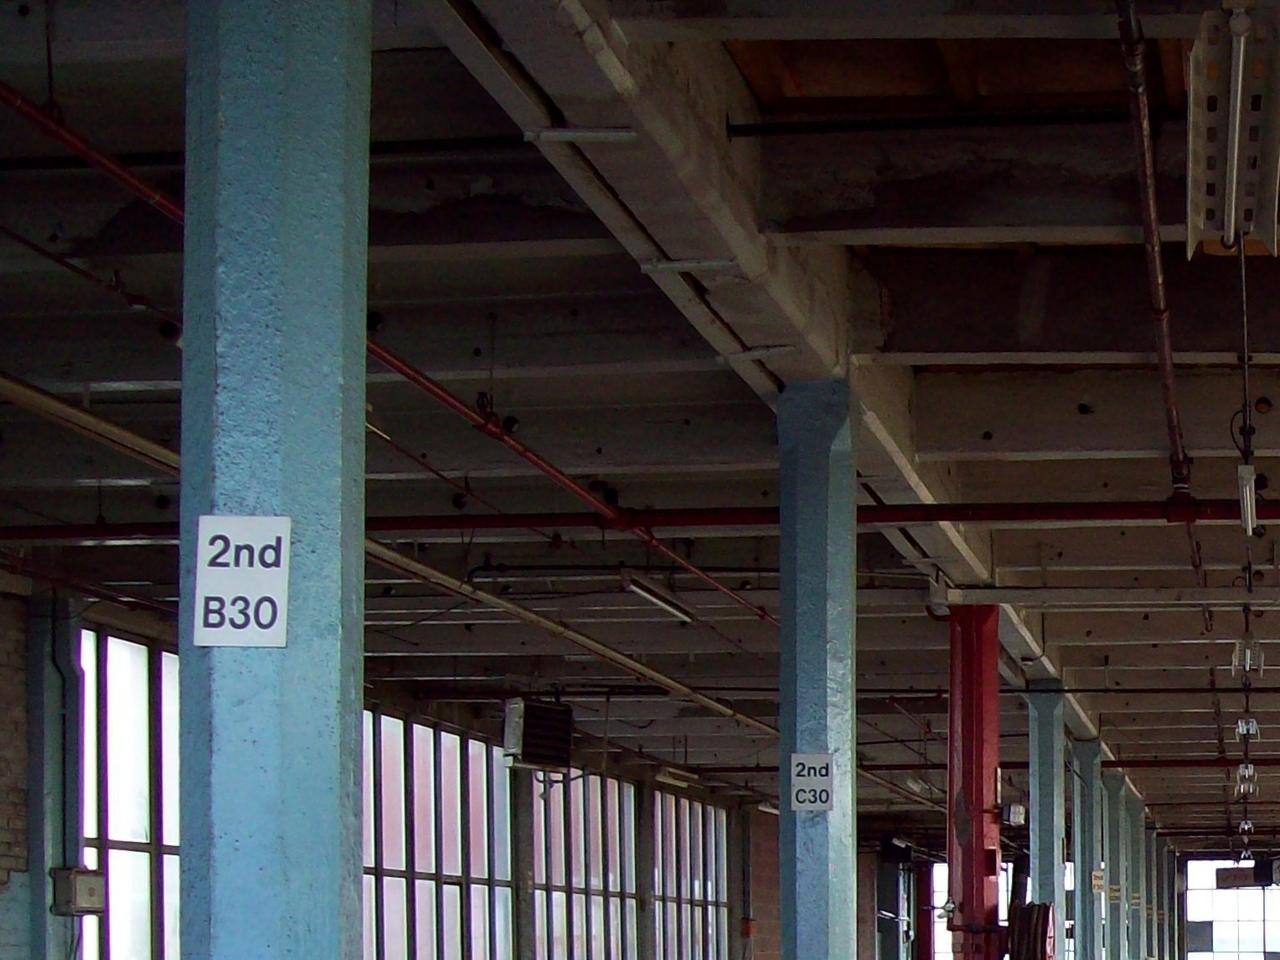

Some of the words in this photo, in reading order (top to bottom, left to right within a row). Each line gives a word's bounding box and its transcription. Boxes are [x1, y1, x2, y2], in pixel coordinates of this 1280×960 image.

[208, 534, 282, 569] 2nd
[203, 595, 278, 630] B30
[795, 762, 829, 778] 2nd
[795, 788, 829, 804] C30
